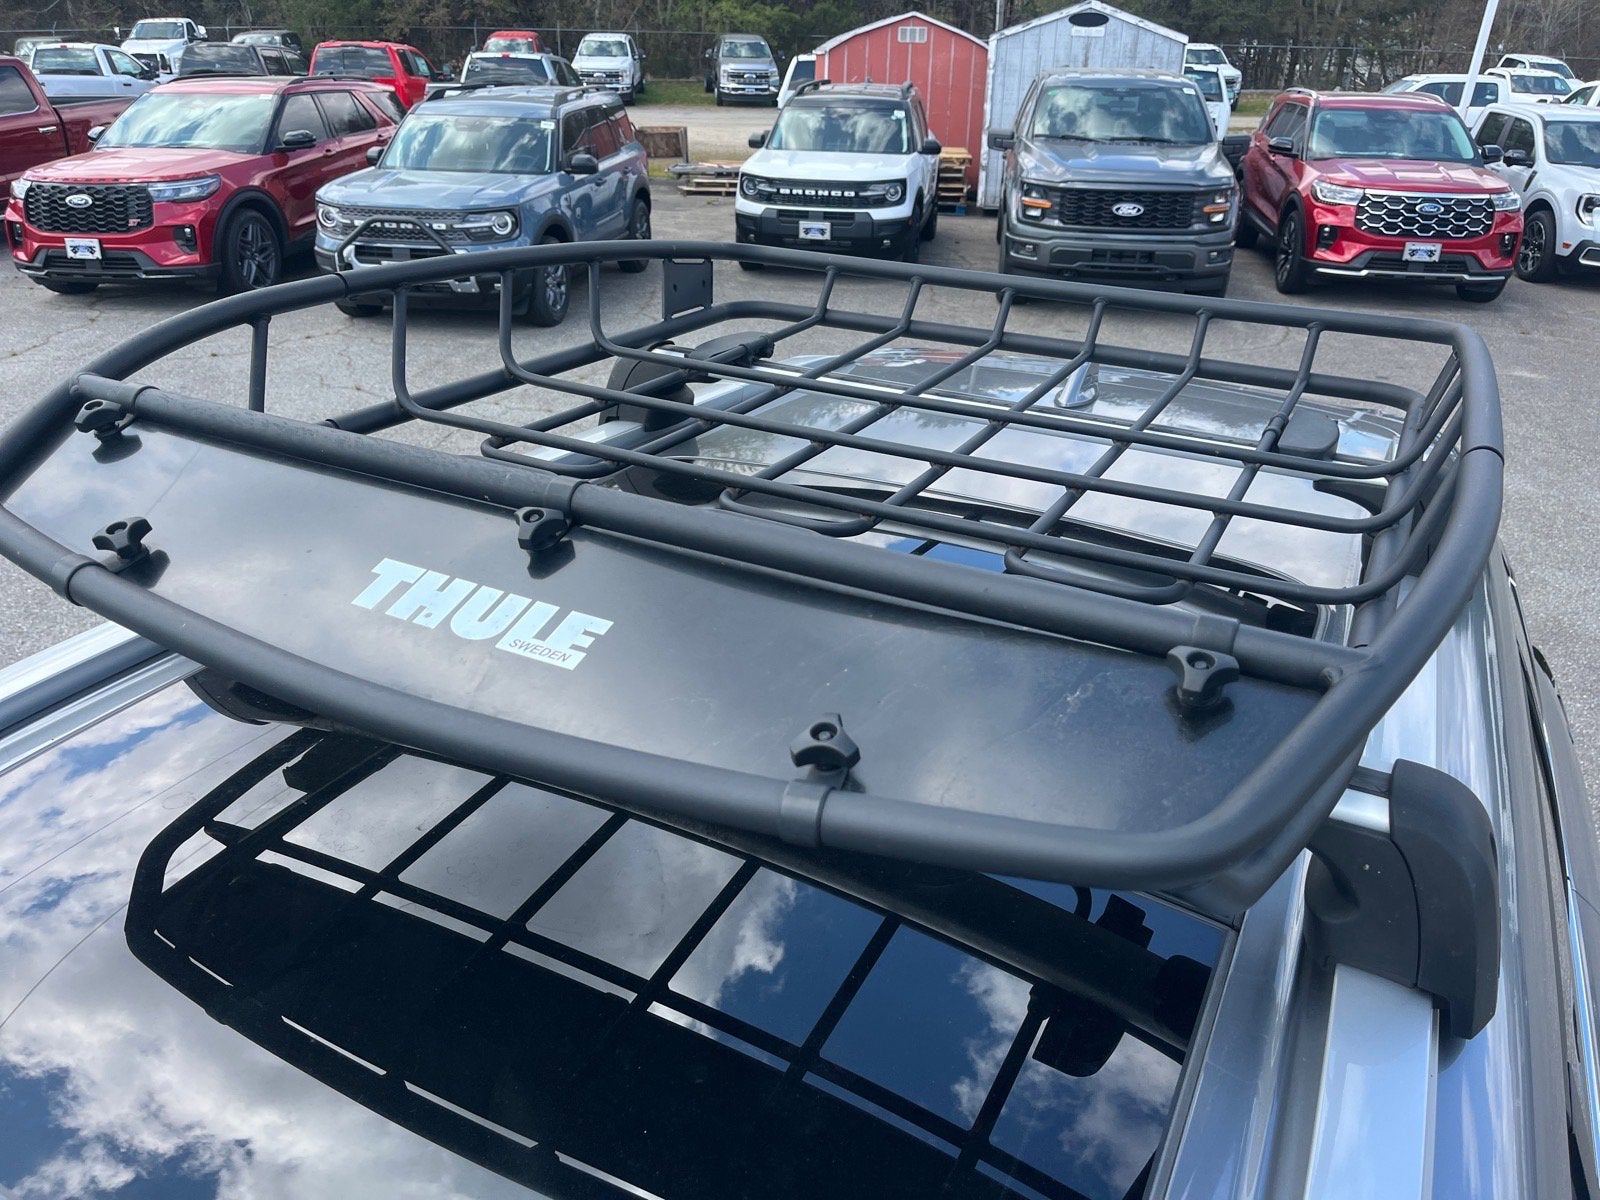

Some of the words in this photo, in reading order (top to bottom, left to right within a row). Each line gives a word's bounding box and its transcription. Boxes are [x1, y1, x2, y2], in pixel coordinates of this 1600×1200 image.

[779, 187, 856, 197] BRONCO
[353, 219, 447, 230] BRONO
[350, 557, 615, 671] THULE
[508, 638, 573, 663] SWEDEN
